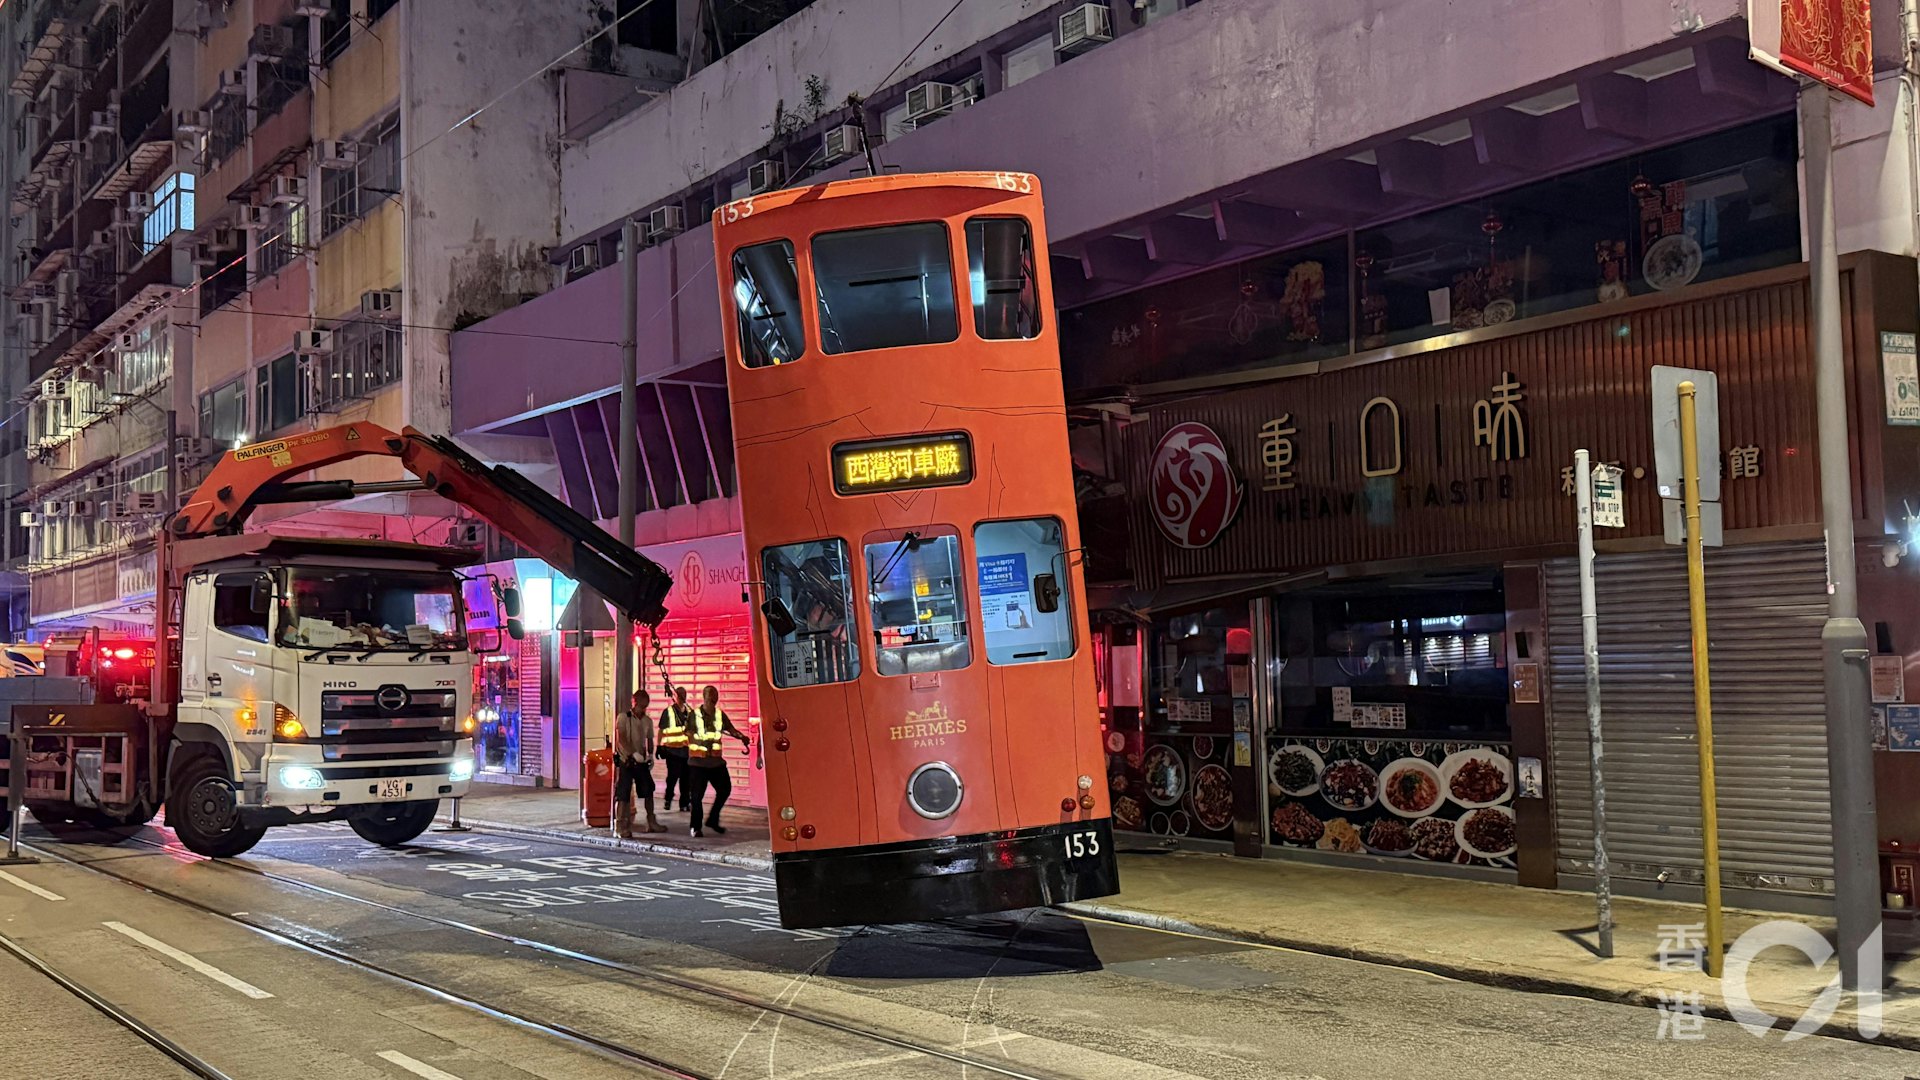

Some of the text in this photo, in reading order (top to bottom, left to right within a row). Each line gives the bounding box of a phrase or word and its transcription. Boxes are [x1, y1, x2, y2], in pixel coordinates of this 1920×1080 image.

[995, 172, 1032, 194] 153
[720, 197, 755, 226] 153
[237, 442, 285, 460] PALFINGER
[288, 440, 298, 448] PK
[1276, 490, 1376, 523] HEAVY
[1608, 503, 1619, 513] STOP
[708, 565, 745, 585] SHANGH
[914, 737, 945, 748] PARIS
[381, 787, 403, 798] 4531
[386, 779, 398, 788] VG
[1065, 831, 1099, 859] 153
[462, 873, 778, 908] ASSENGERS
